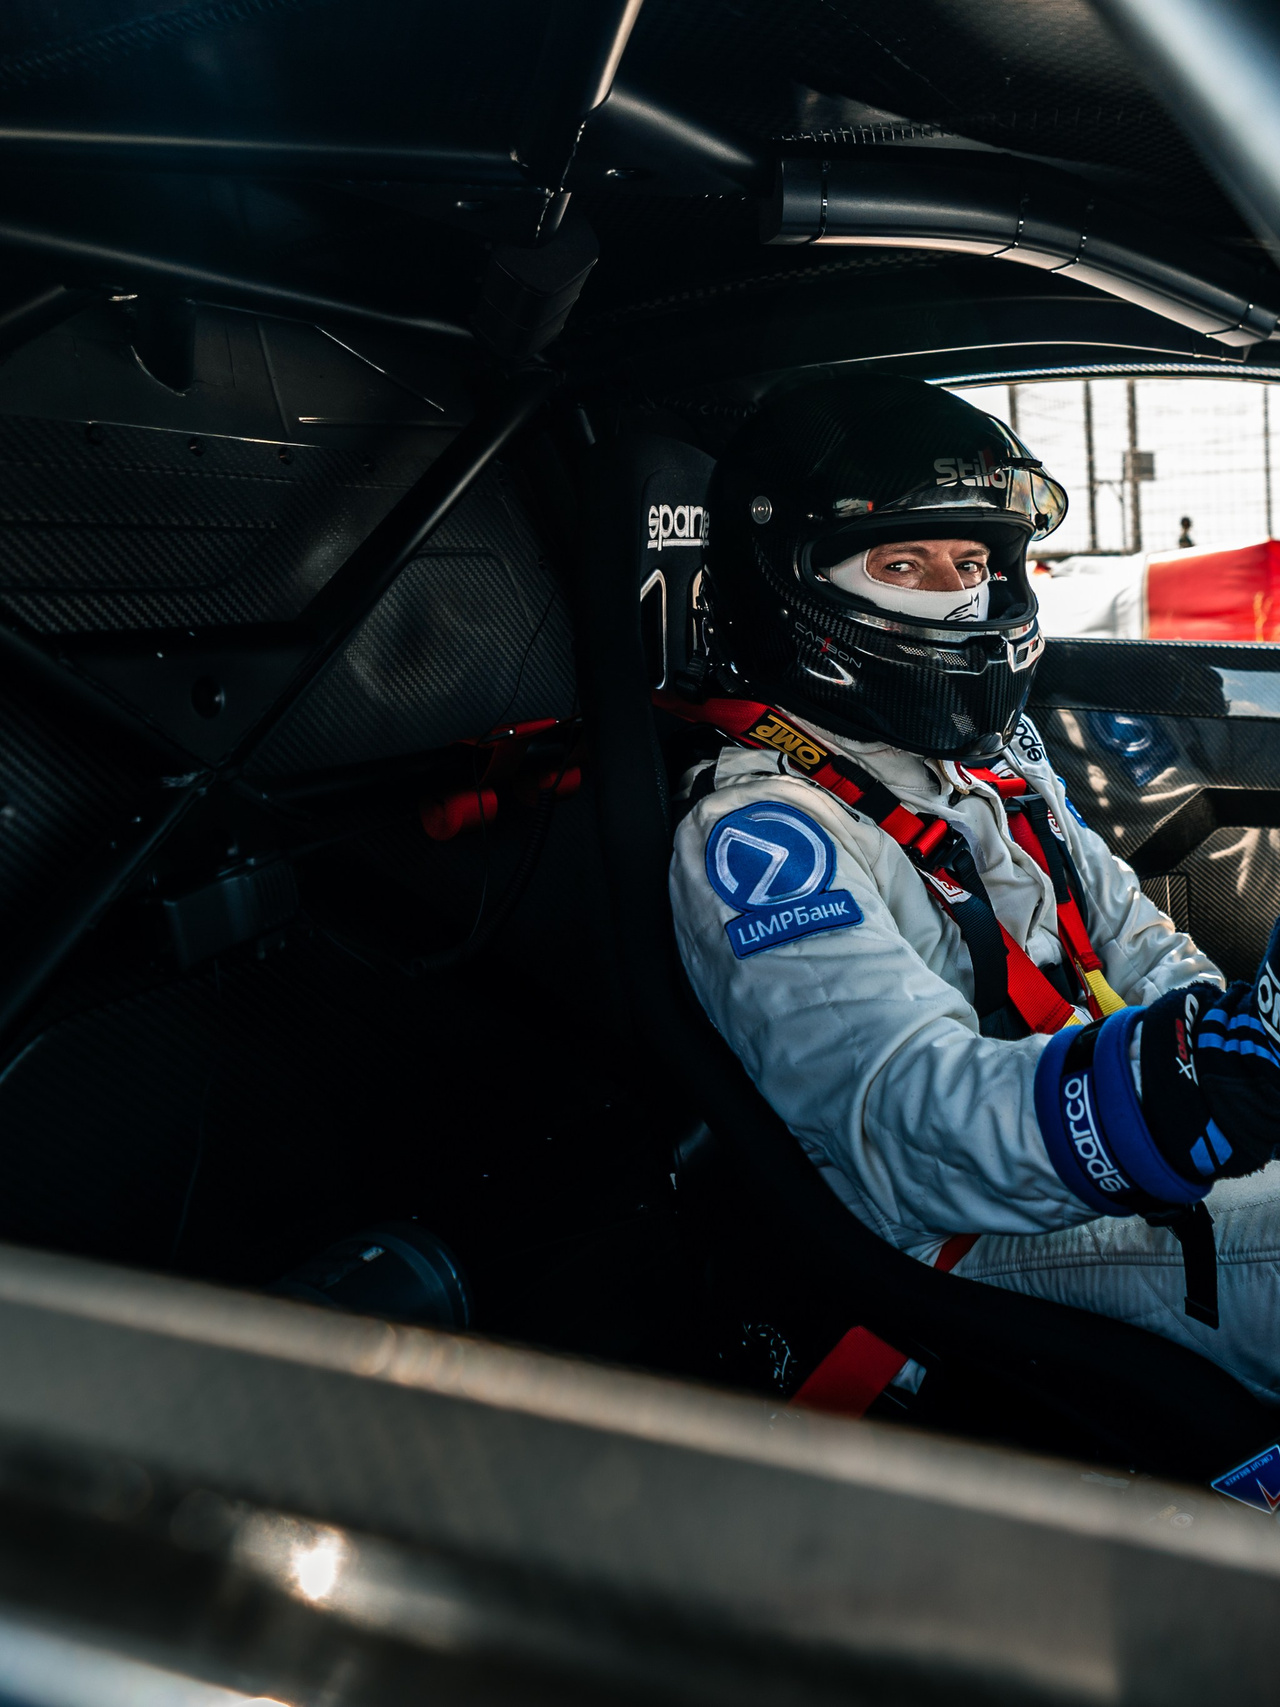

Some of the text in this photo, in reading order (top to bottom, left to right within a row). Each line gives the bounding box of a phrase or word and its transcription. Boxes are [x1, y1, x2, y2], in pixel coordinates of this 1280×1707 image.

[933, 448, 1007, 489] Stilo
[647, 504, 703, 551] spar
[795, 621, 862, 669] CARBON
[755, 723, 820, 765] OMP
[738, 901, 850, 945] ЦМРБанк
[1065, 1078, 1118, 1192] sparco
